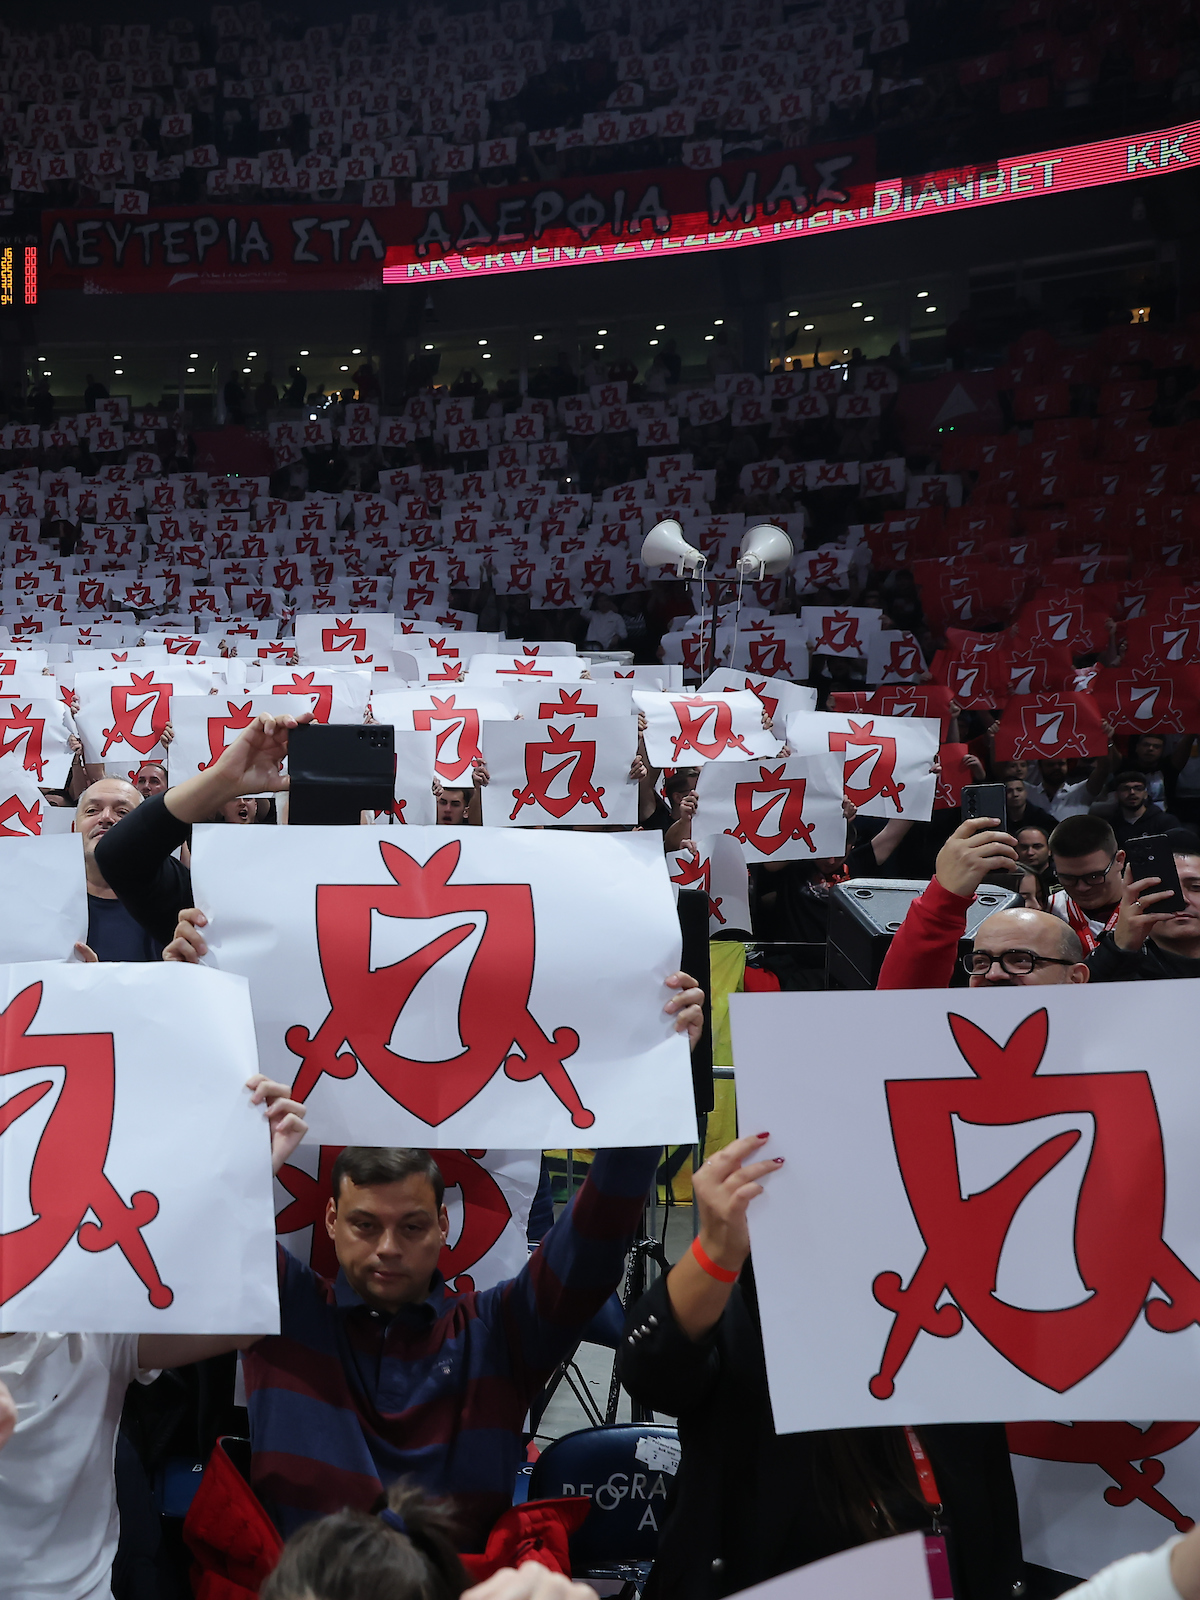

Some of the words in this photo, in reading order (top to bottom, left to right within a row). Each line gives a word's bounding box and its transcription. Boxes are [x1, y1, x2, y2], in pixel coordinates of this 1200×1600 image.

[1127, 134, 1190, 173] KK
[48, 216, 270, 265] ΛΕΥΤΕΡΙΑ
[291, 217, 385, 262] ΣΤΑ
[416, 186, 670, 255] ΑΔΕΡΦΙΑ
[708, 155, 854, 223] ΜΑΣ
